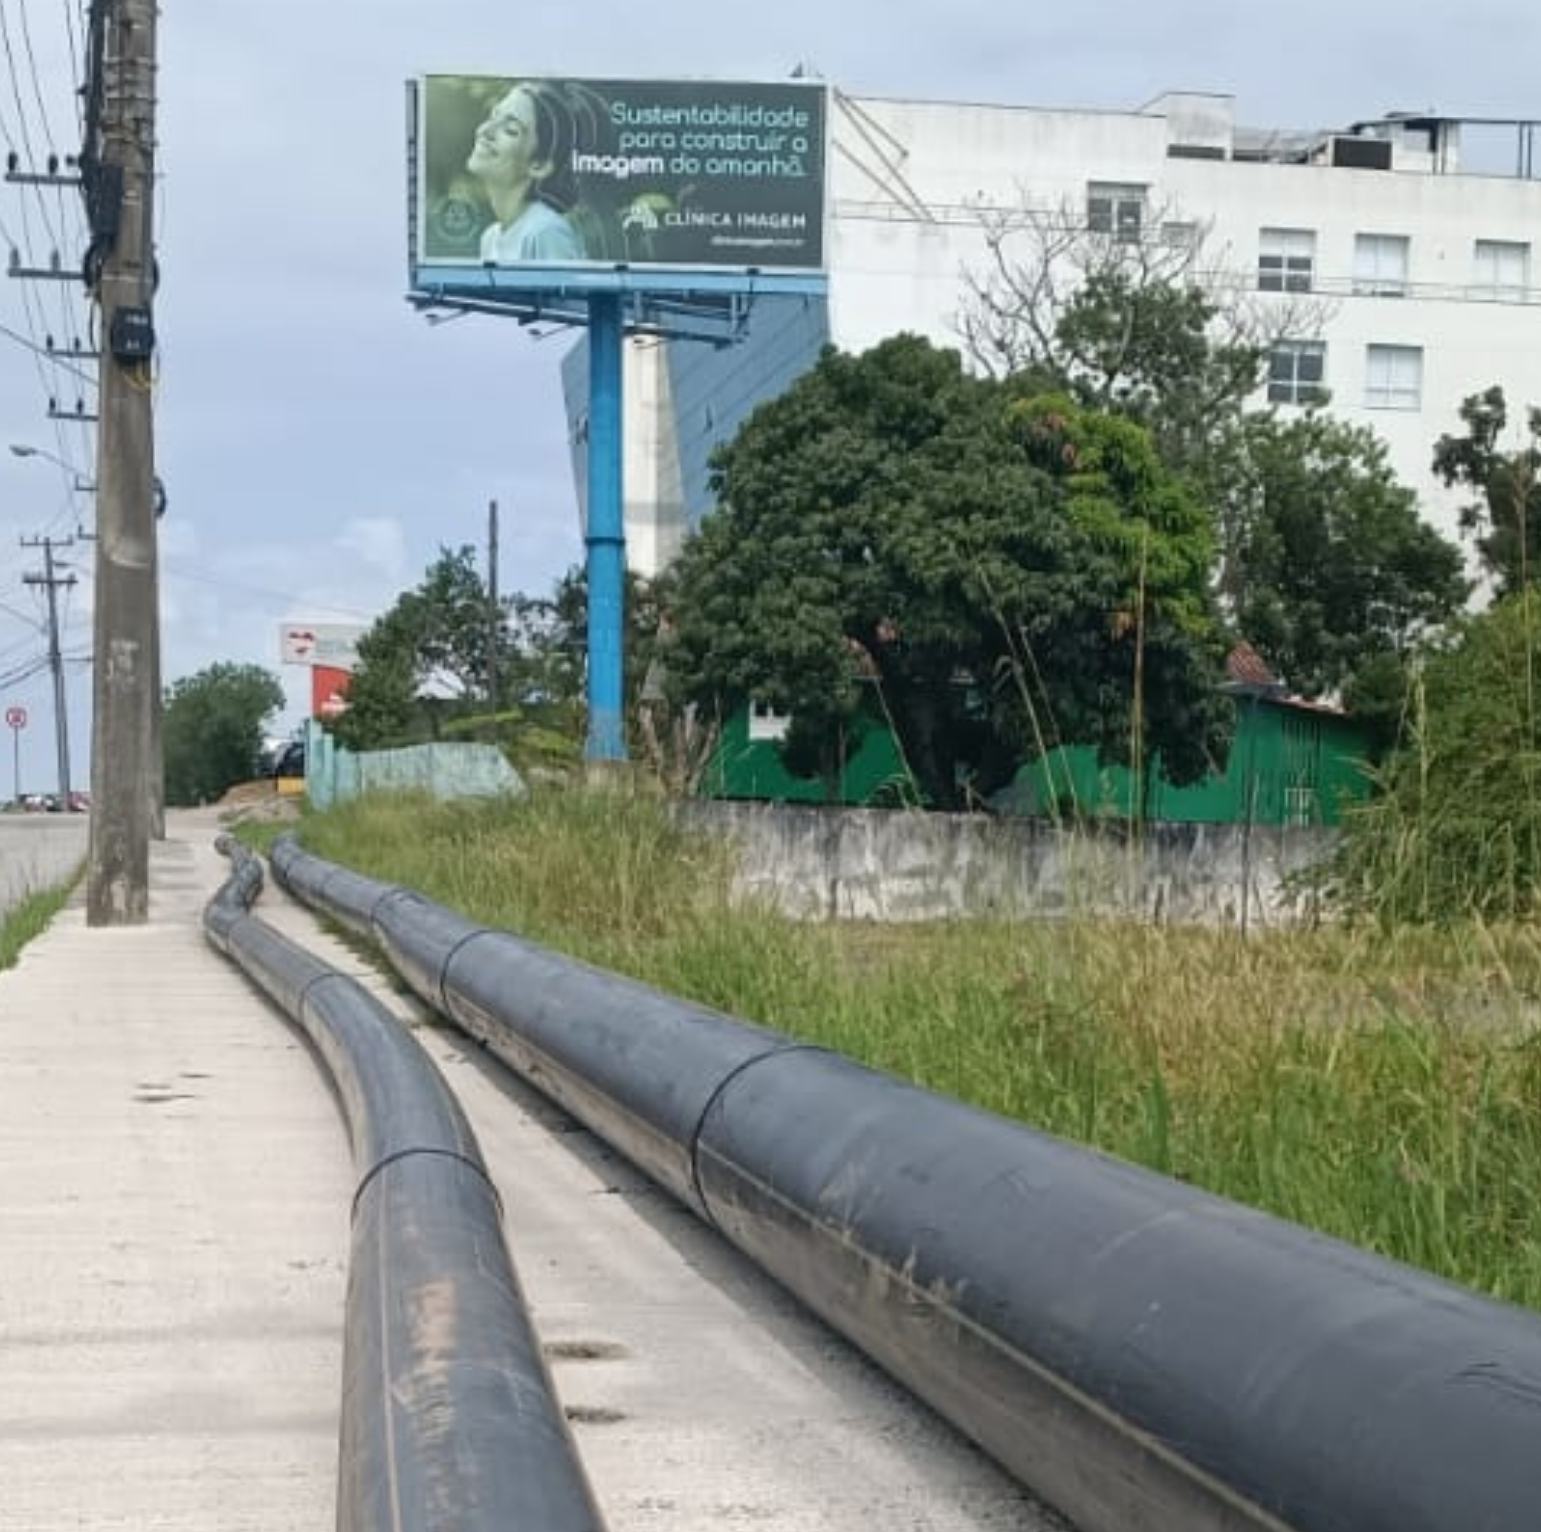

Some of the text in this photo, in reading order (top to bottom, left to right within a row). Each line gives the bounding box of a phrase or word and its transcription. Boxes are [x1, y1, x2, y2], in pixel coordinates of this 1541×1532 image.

[611, 103, 809, 128] Sustentabilidade
[620, 128, 808, 153] para construir a
[665, 208, 807, 229] CLÍNICA IMAGEM
